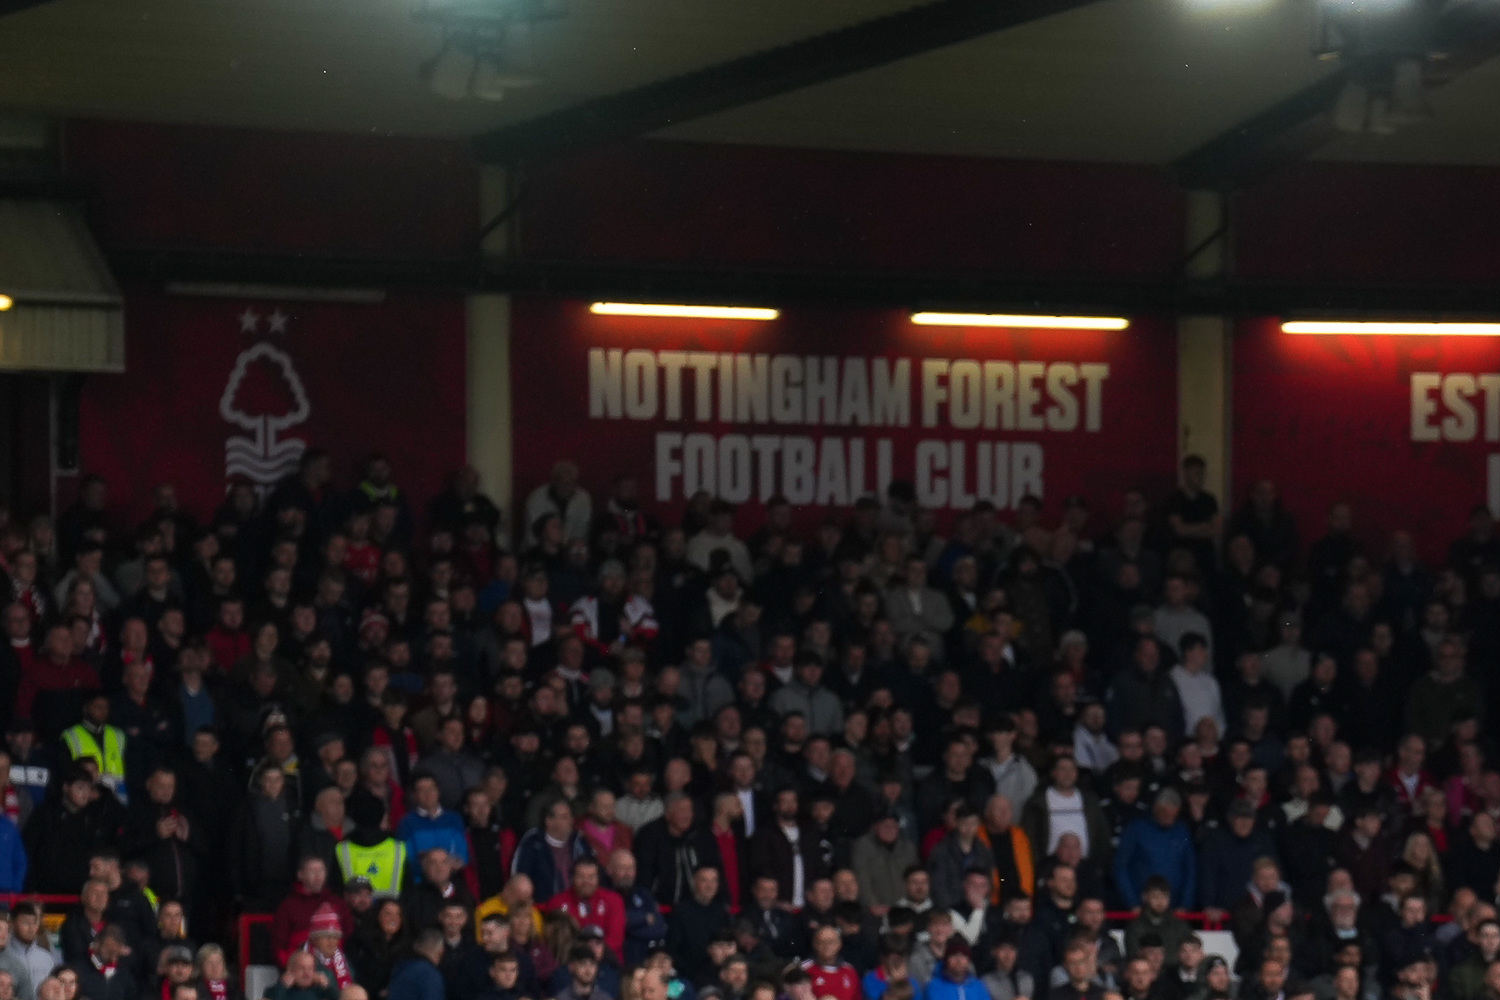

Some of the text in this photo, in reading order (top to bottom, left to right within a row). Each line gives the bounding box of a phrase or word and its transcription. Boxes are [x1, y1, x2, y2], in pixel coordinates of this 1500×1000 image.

[588, 347, 1109, 433] NOTTINGHAM FOREST
[655, 432, 1043, 509] FOOTBALL CLUB
